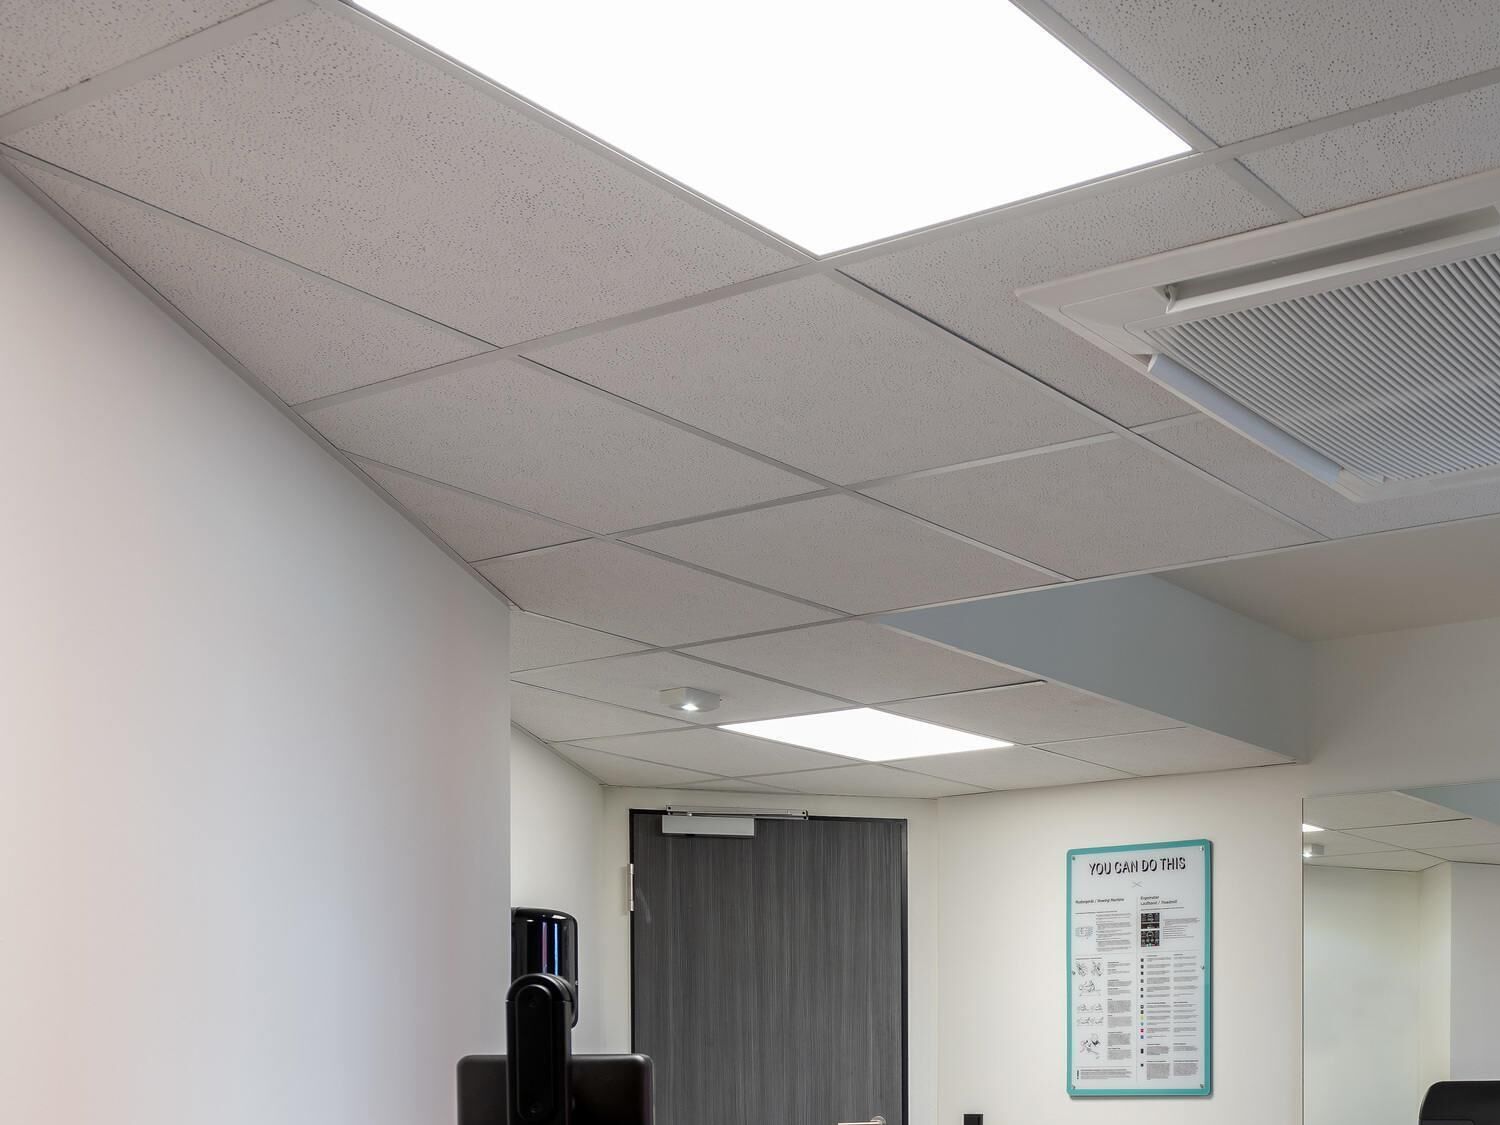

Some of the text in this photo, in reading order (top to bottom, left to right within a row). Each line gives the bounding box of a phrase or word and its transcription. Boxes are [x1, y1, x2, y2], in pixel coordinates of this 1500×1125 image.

[1089, 857, 1186, 876] YOU CAN DO THIS
